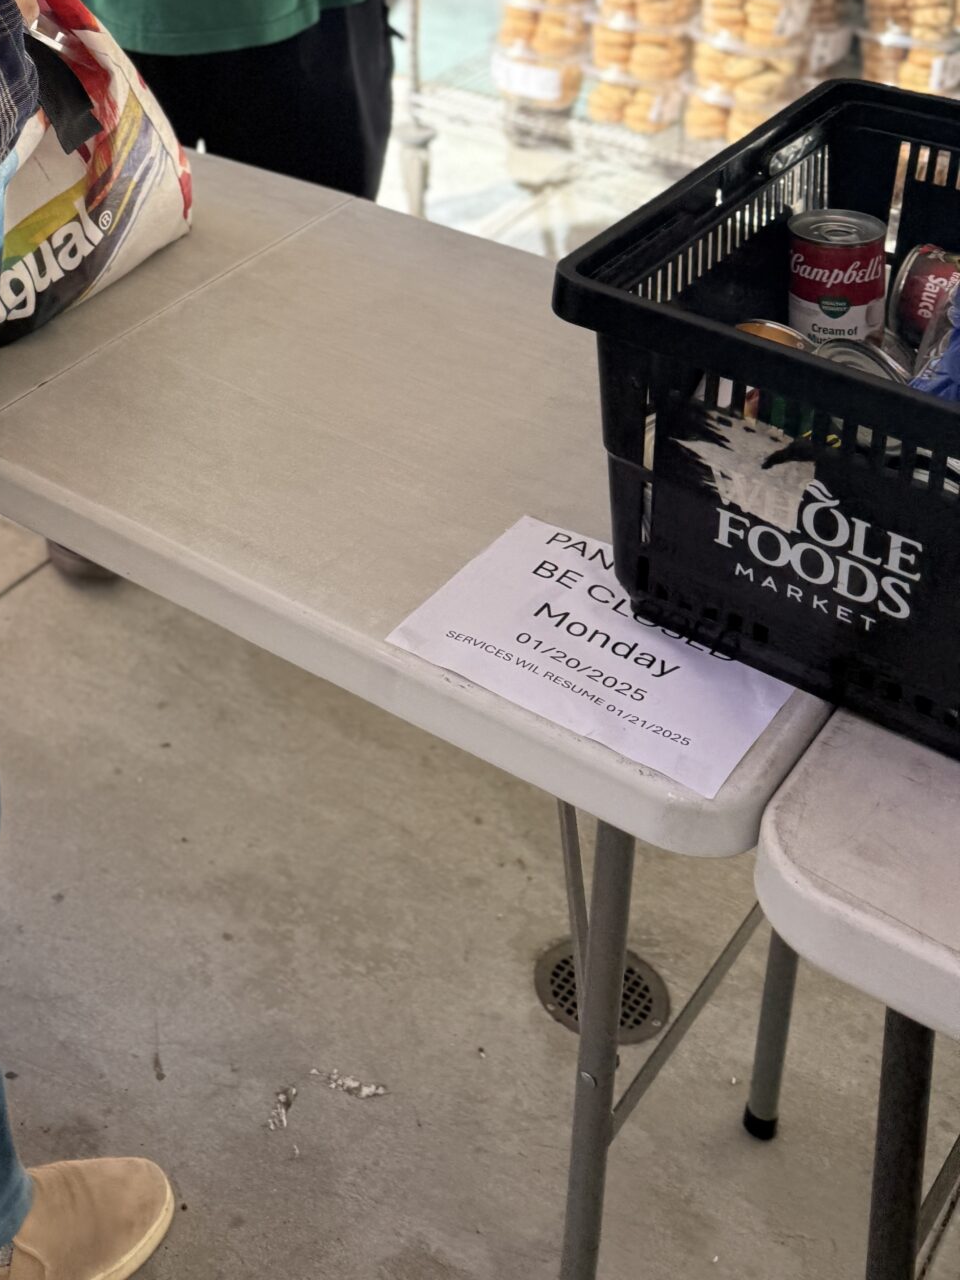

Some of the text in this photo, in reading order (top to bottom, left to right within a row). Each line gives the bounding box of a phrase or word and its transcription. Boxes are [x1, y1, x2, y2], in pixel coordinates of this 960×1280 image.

[811, 323, 859, 336] Cream of
[917, 274, 948, 319] Sauce
[713, 507, 912, 620] FOODS
[791, 479, 924, 582] OLE
[531, 559, 585, 590] BE
[734, 562, 877, 632] MARKET
[515, 631, 648, 702] 01/20/2025
[533, 601, 682, 679] Monday
[445, 629, 693, 747] SERVICES WIL RESUME 01/21/2025
